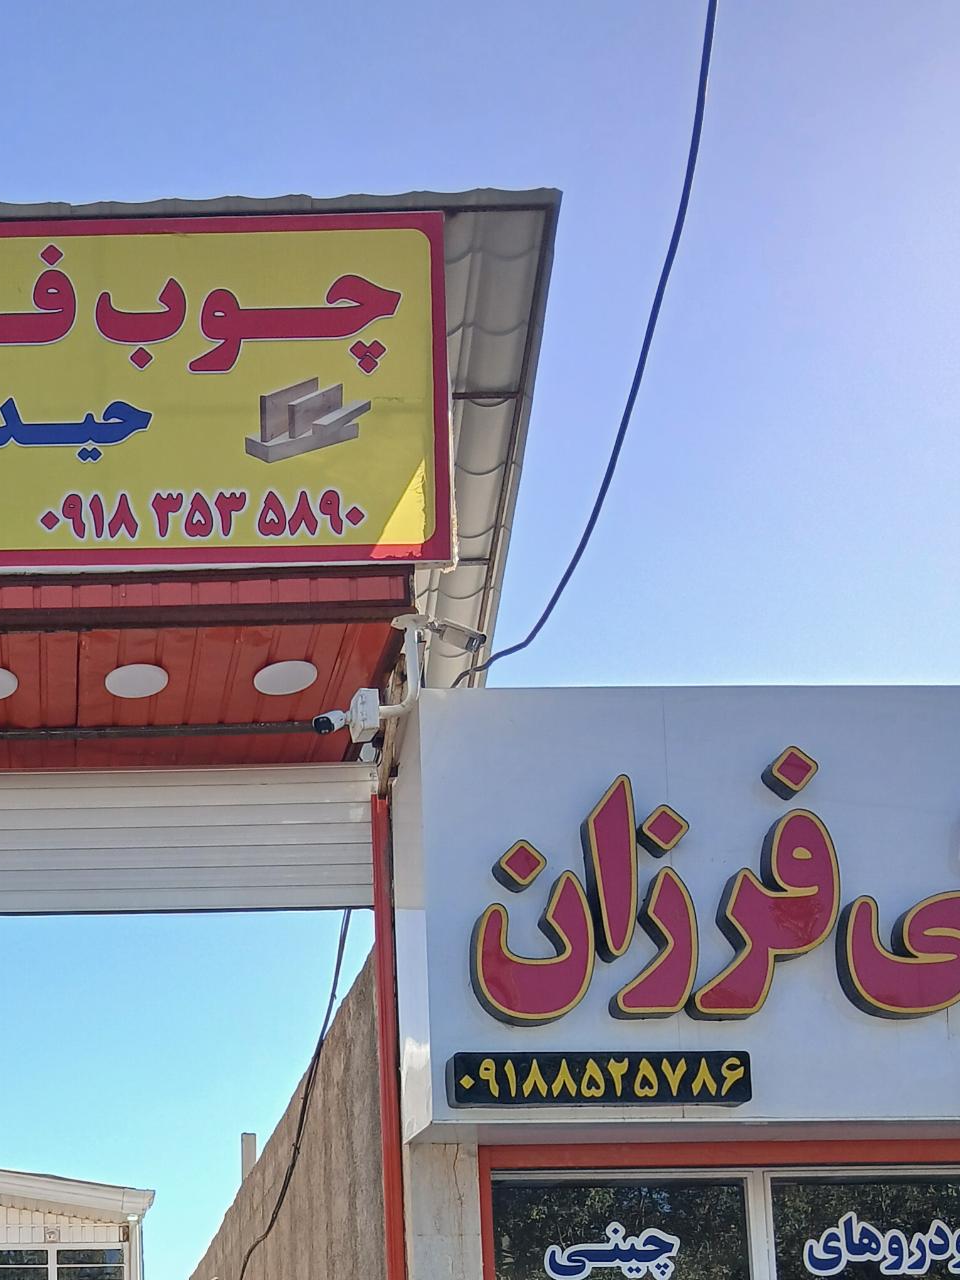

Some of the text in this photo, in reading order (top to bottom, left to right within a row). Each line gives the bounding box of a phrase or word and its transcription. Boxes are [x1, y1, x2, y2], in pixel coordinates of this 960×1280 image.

[95, 272, 403, 376] چوب
[39, 489, 365, 539] ۰۹۱۸ ۳۵۳ ۵۸۹۰
[471, 745, 960, 1027] ی فرزان
[459, 1057, 745, 1098] ۰۹۱۸۸۵۲۵۷۸۶
[803, 1211, 960, 1276] دروهای
